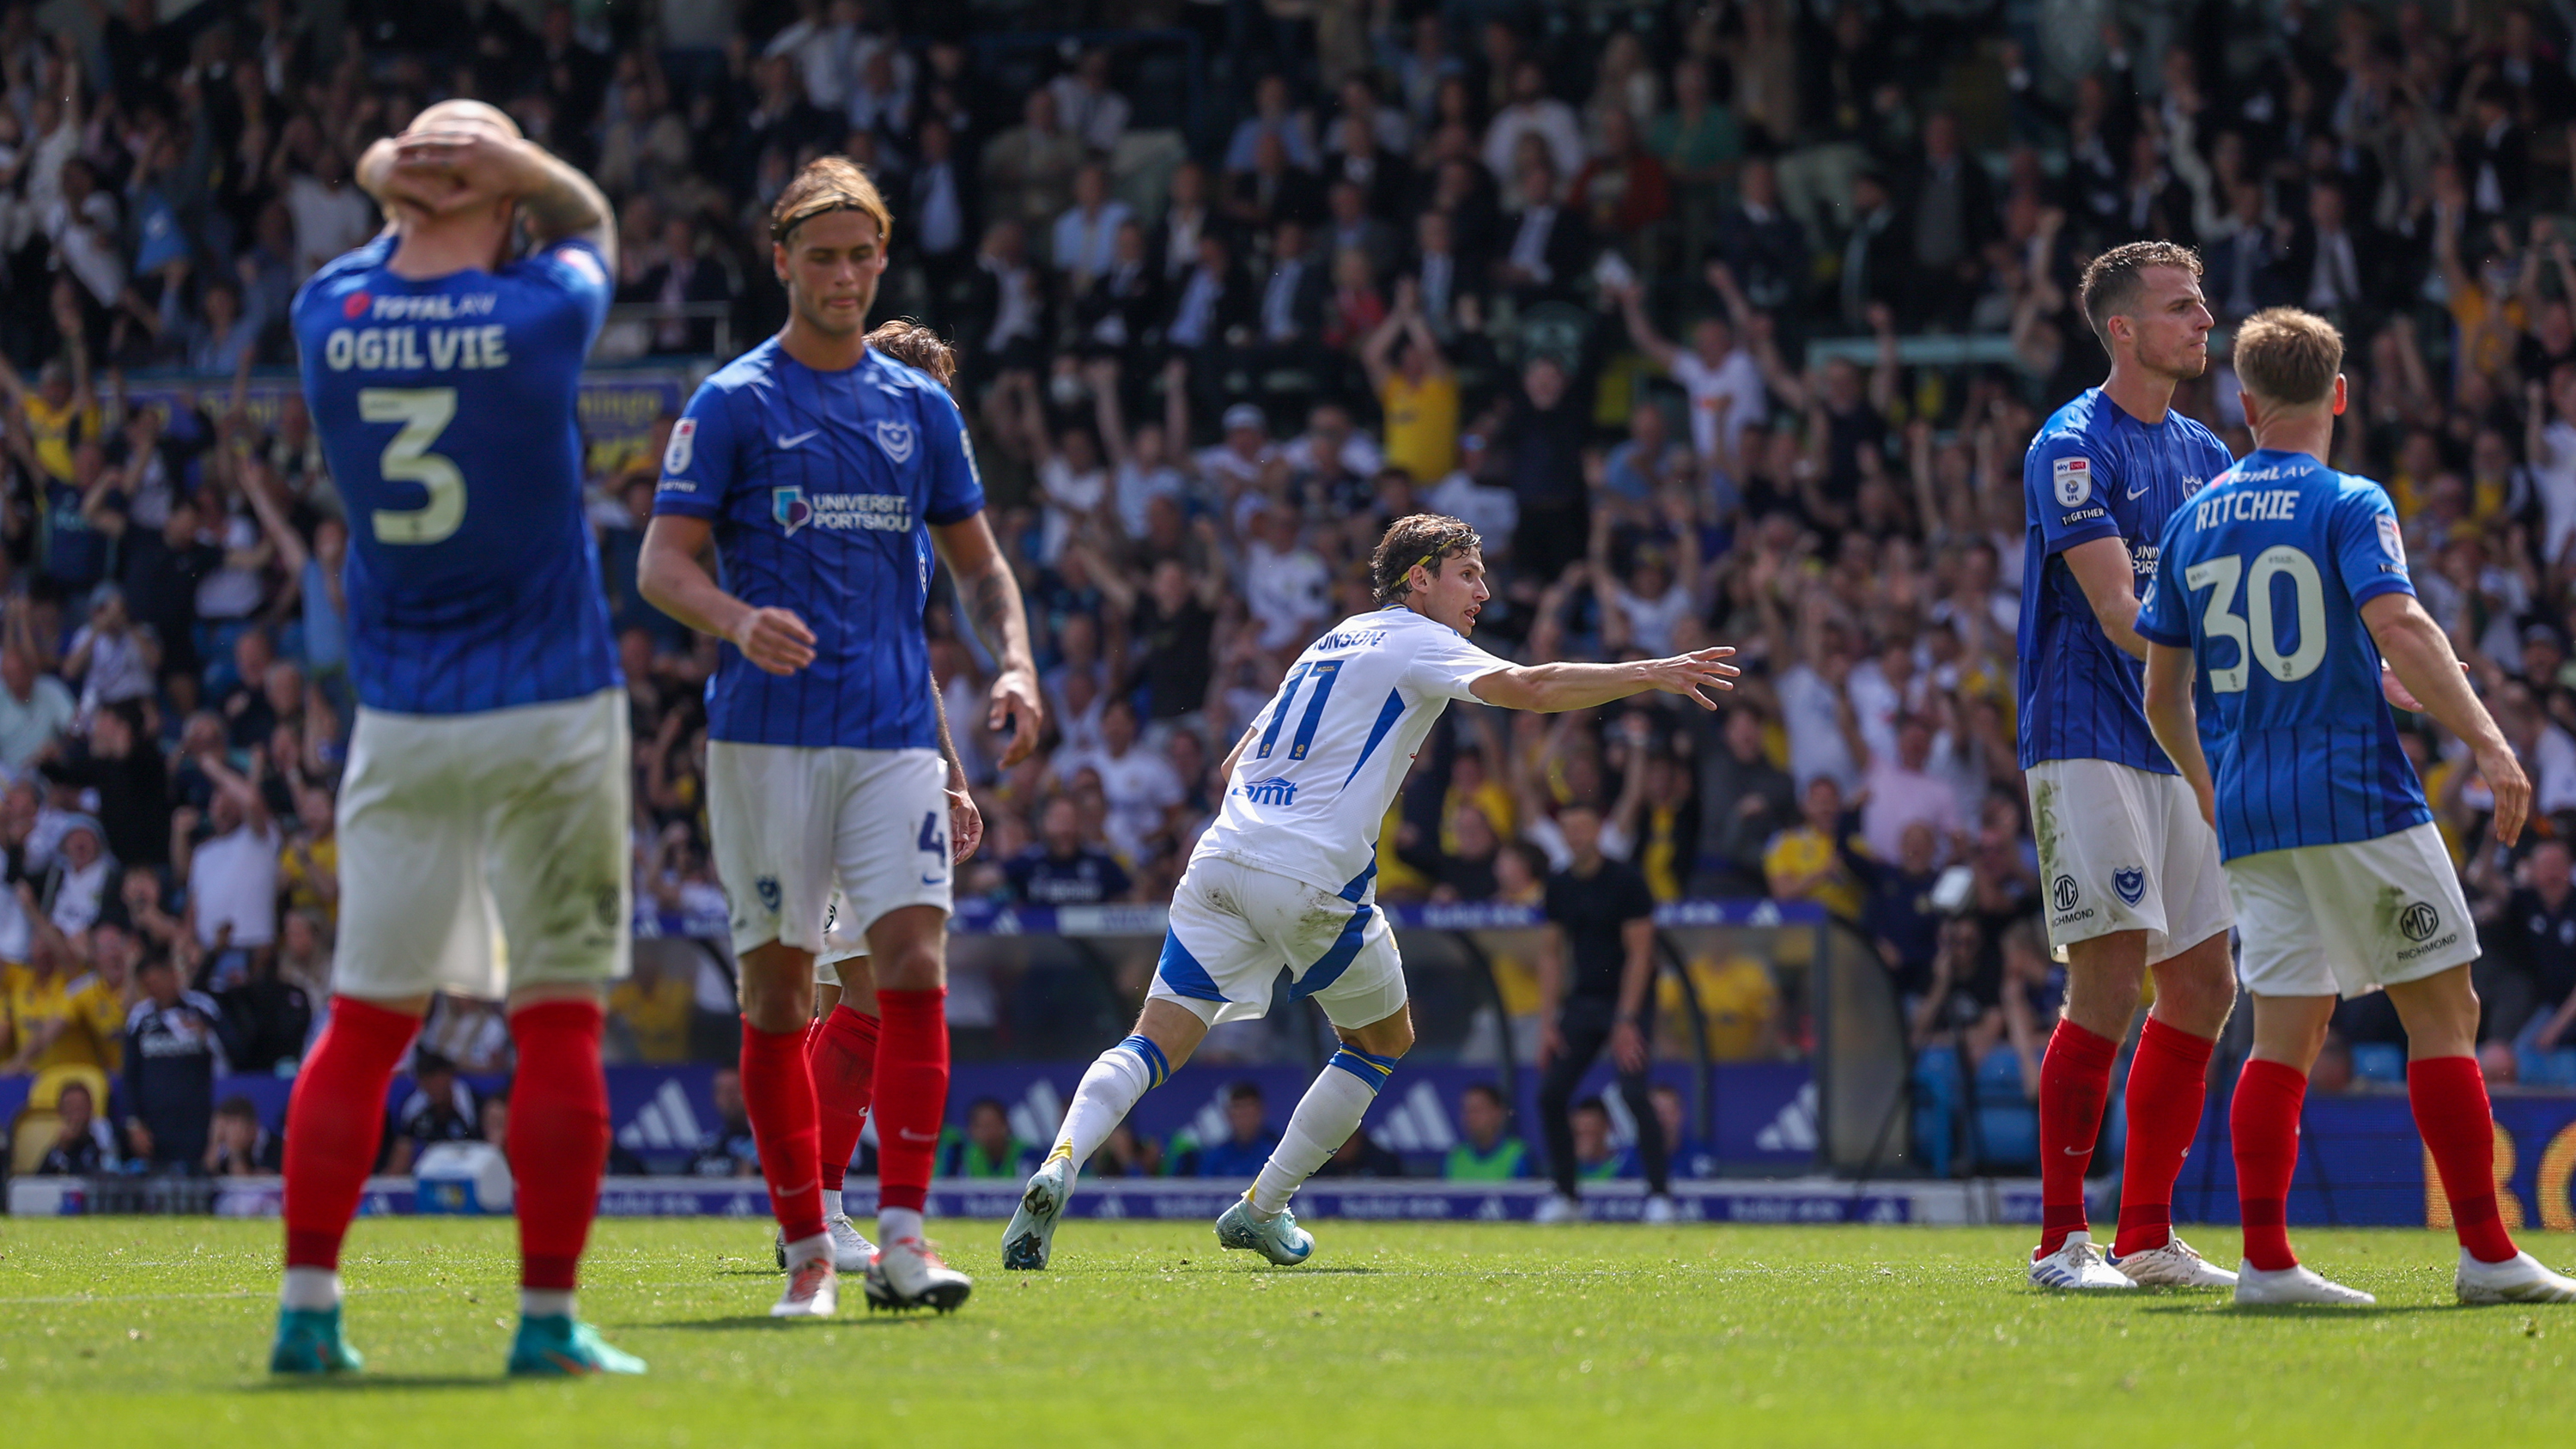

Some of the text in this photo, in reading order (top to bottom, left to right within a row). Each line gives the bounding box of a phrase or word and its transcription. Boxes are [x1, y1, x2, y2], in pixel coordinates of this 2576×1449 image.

[325, 324, 510, 371] OGILVIE
[358, 387, 467, 545] 3
[812, 493, 912, 513] UNIVERSIT
[2195, 489, 2300, 533] RITCHIE
[2185, 544, 2327, 693] 30
[1256, 660, 1345, 761] 11
[918, 811, 946, 868] 4
[2053, 878, 2076, 908] MG
[2405, 907, 2435, 937] MG
[2397, 934, 2457, 961] RICHMOND
[2129, 1256, 2143, 1264] COPA
